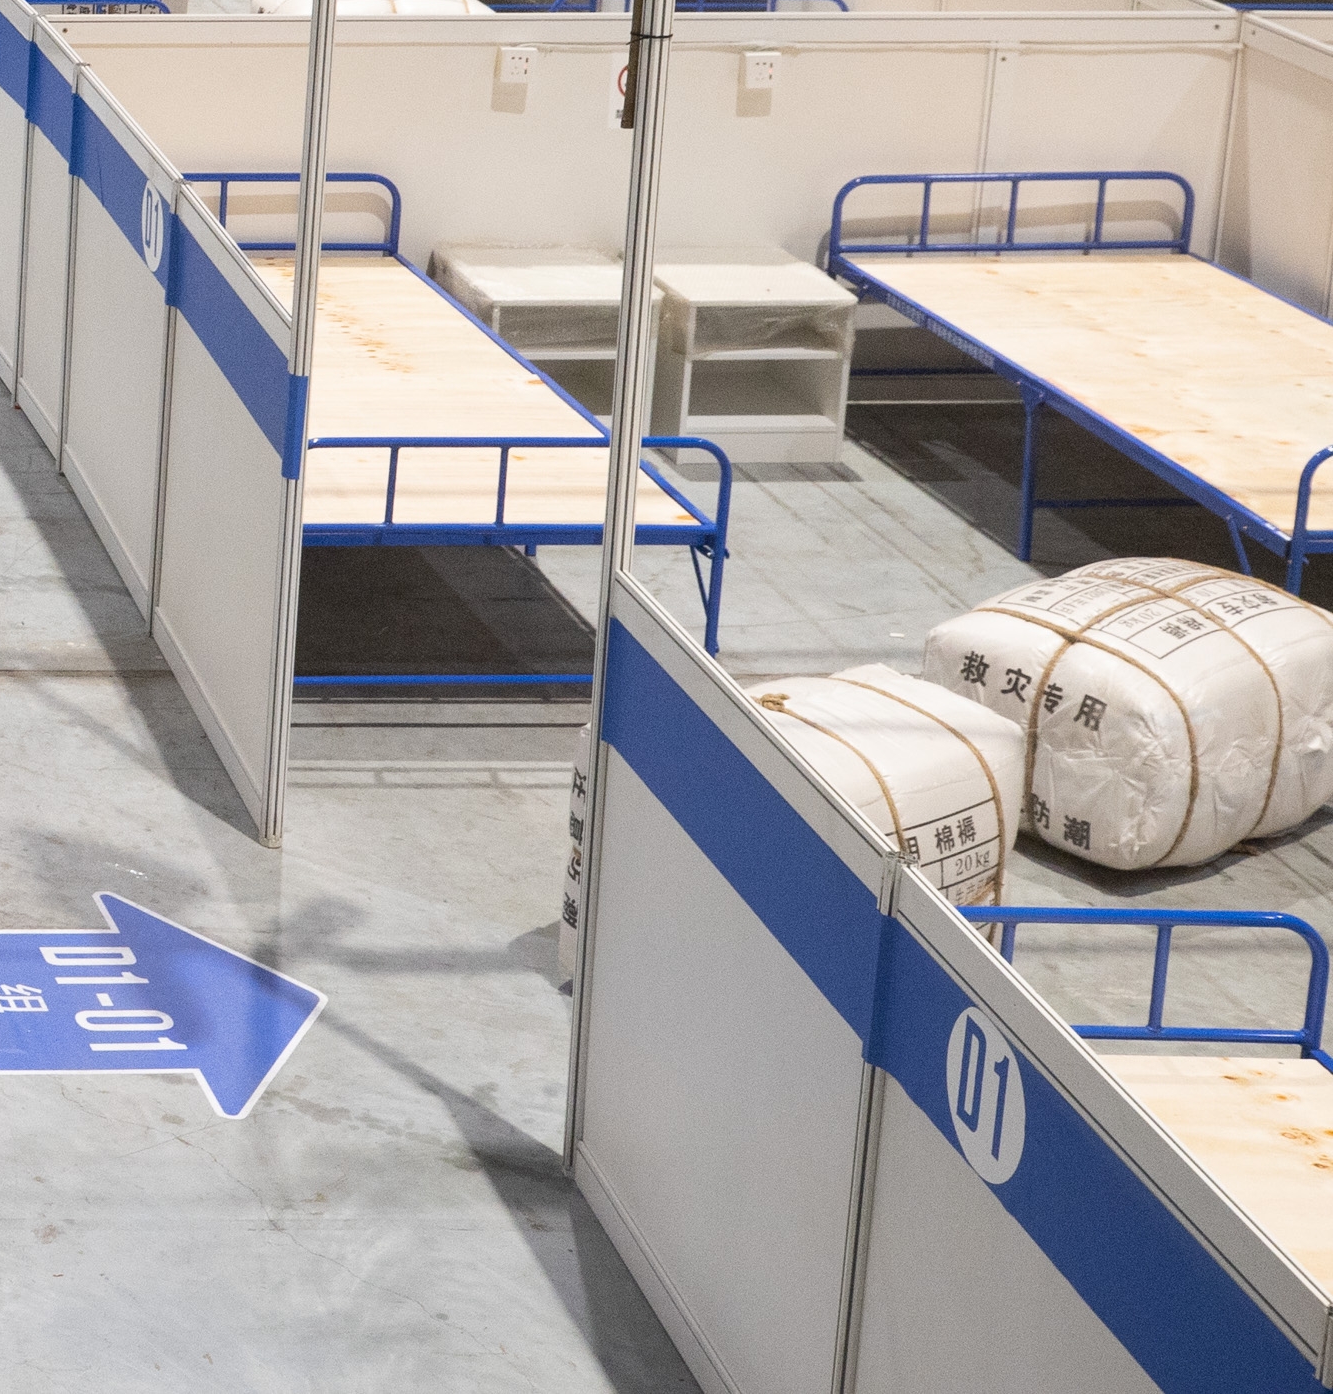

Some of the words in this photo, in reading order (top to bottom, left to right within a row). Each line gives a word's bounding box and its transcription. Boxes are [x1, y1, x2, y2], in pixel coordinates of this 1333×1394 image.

[960, 650, 1108, 732] 救灾专用
[934, 815, 977, 856] 棉褥
[38, 945, 189, 1053] D1-01
[956, 1013, 1010, 1161] D1
